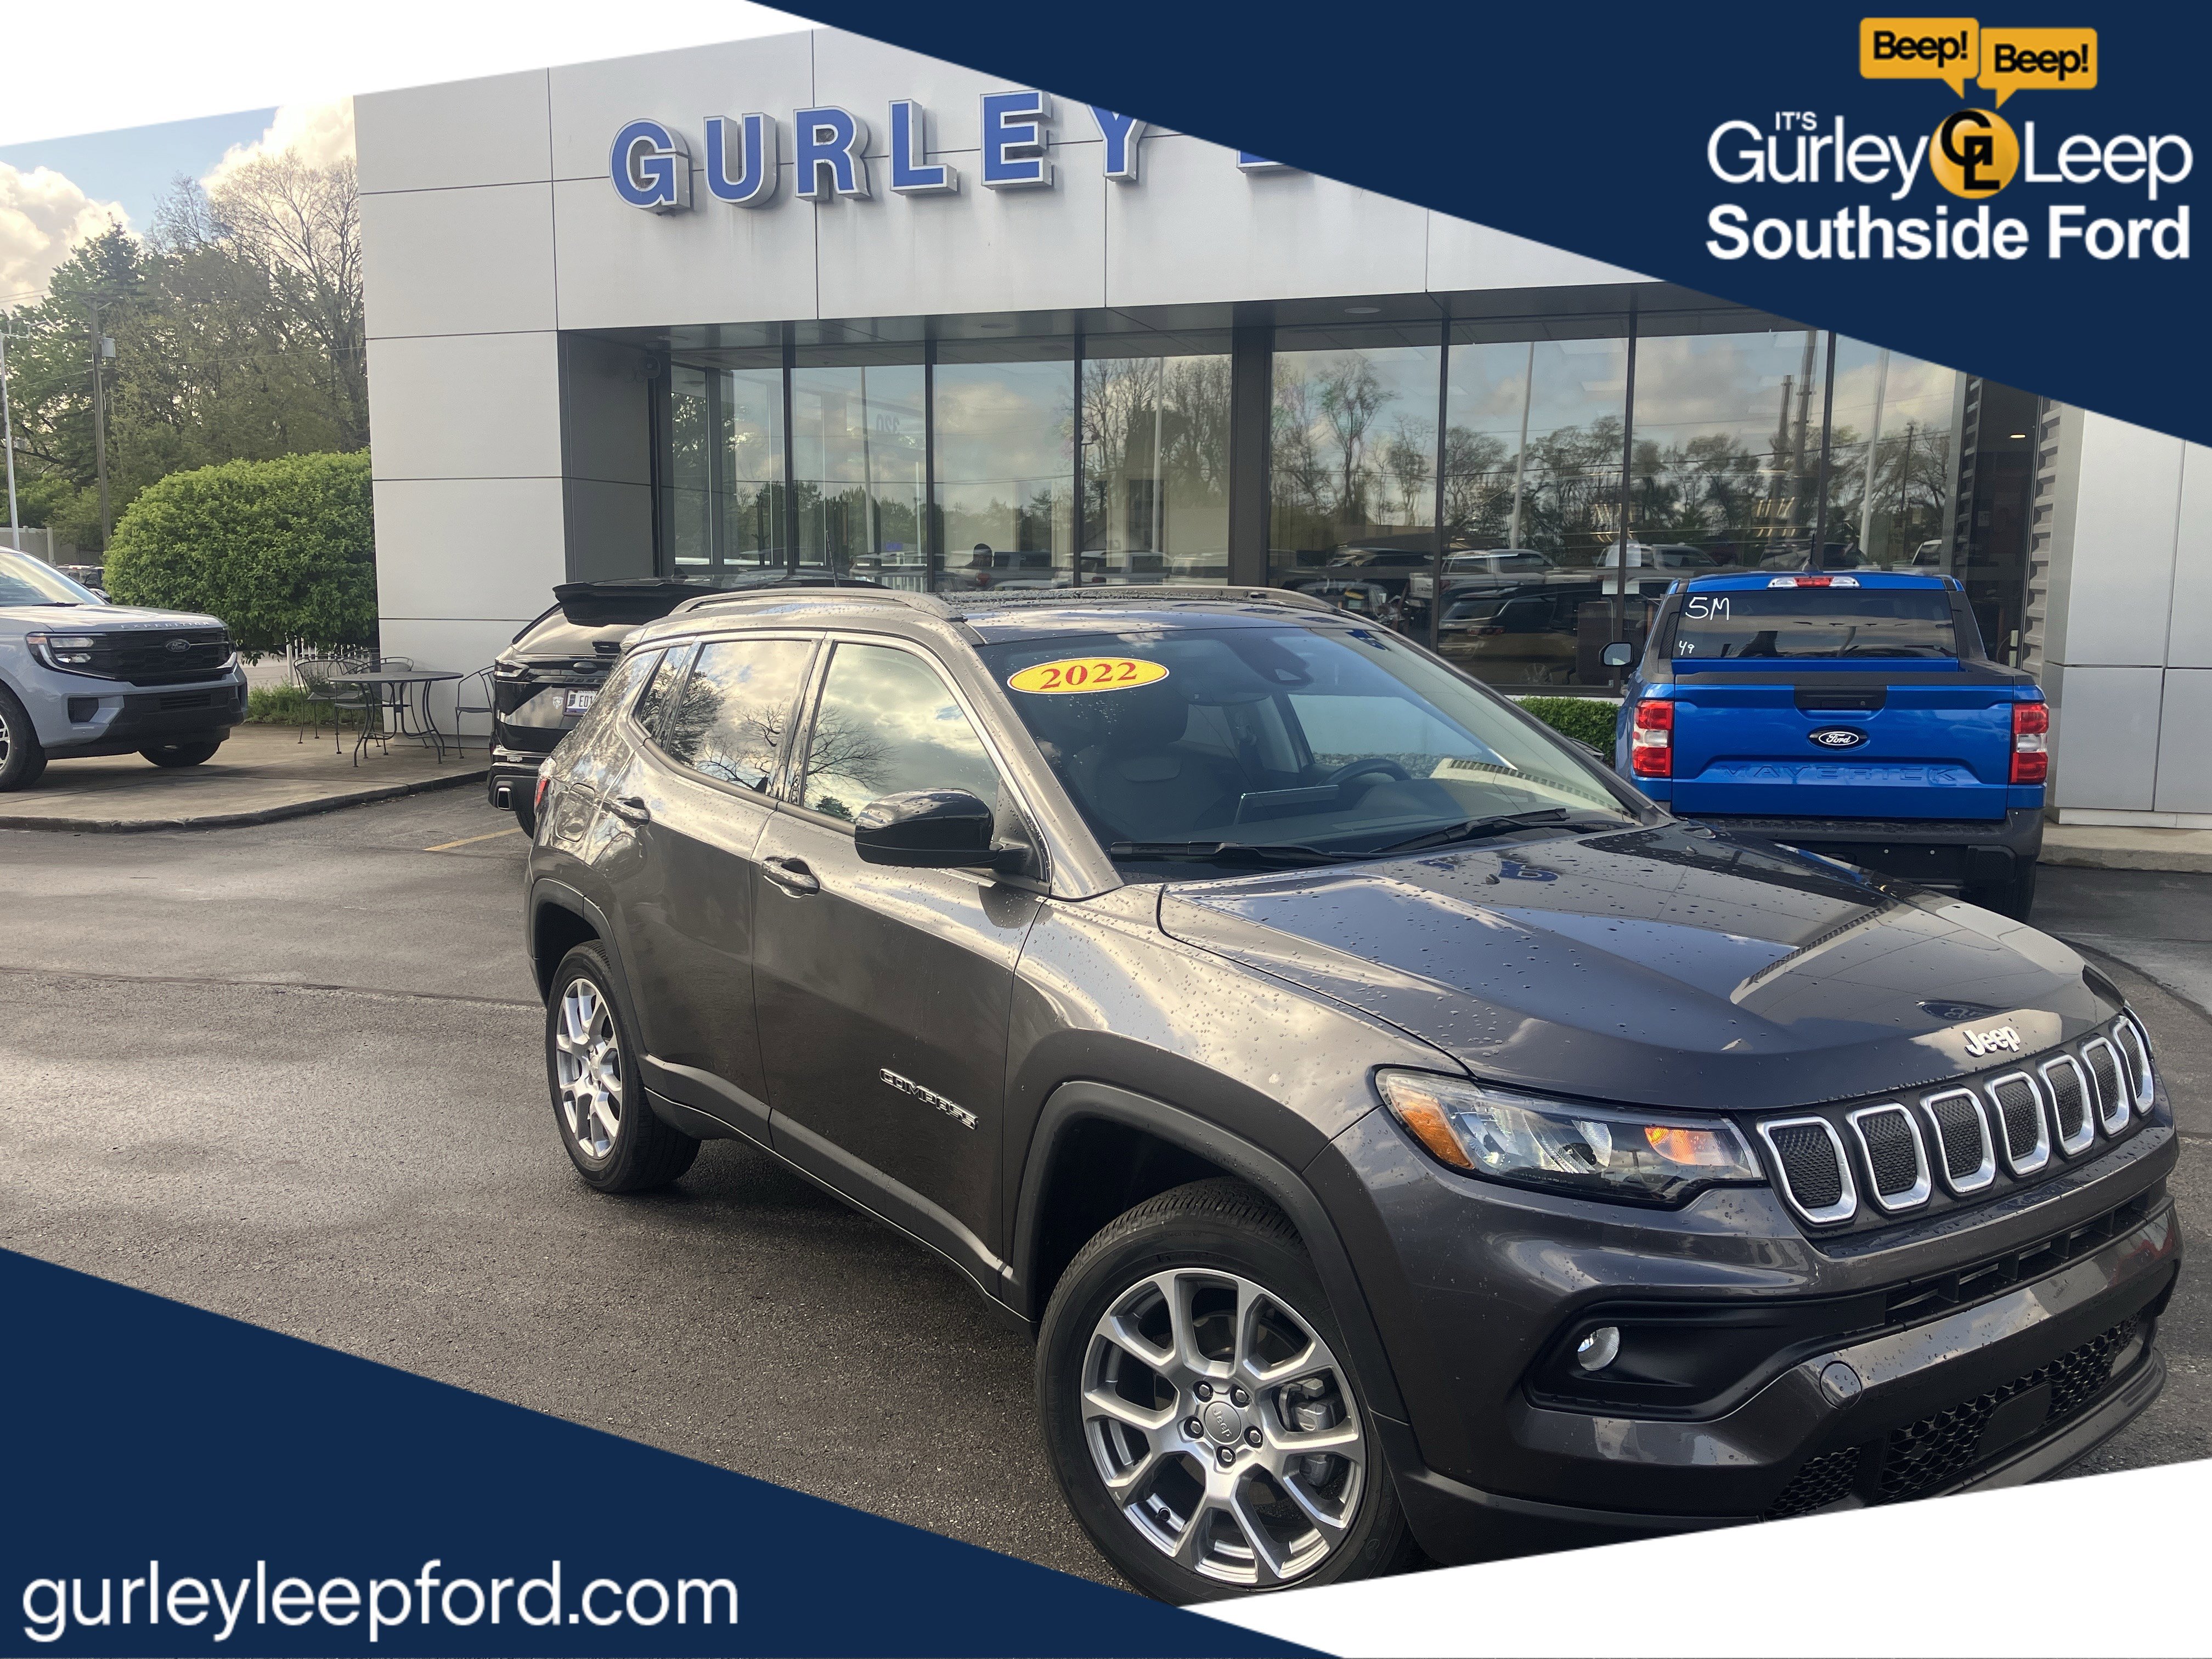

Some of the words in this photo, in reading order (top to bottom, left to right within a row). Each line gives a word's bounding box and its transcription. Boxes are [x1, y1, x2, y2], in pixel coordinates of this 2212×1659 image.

[609, 91, 1147, 211] GURLEY
[1039, 662, 1138, 690] 2022
[1826, 733, 1852, 743] Ford
[1962, 1026, 2021, 1058] Jeep
[1211, 1408, 1233, 1437] Jeep
